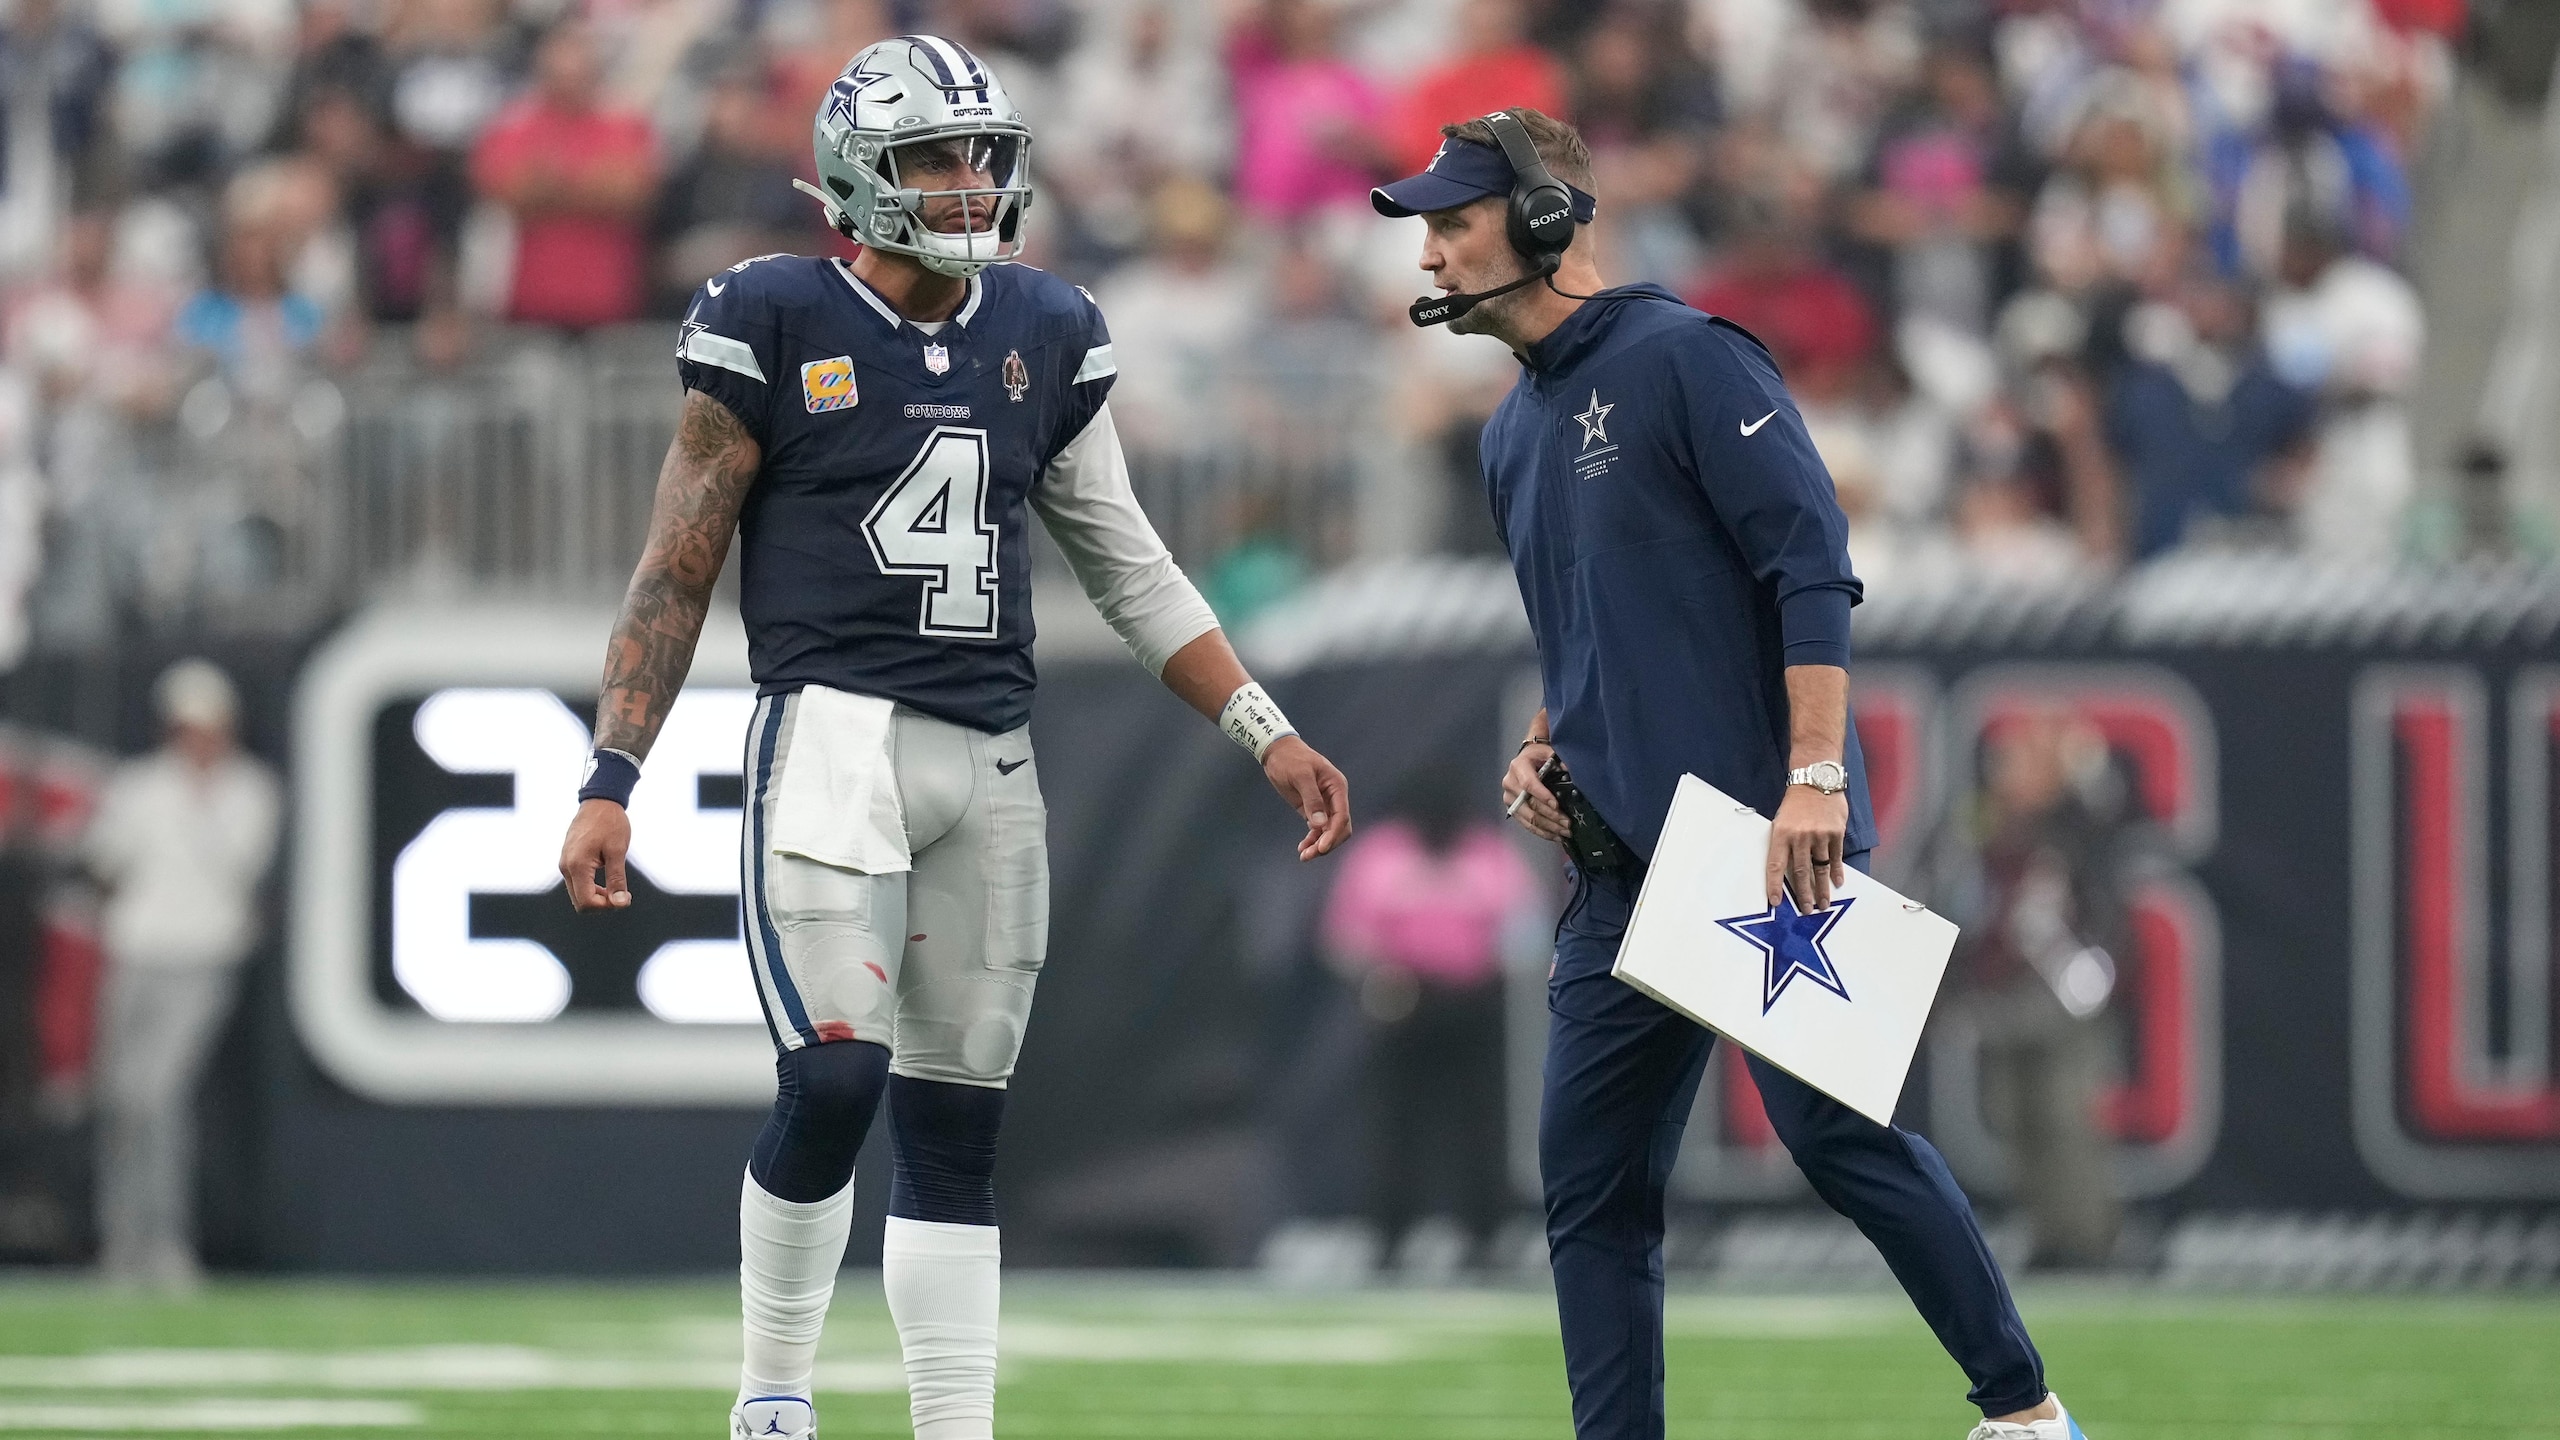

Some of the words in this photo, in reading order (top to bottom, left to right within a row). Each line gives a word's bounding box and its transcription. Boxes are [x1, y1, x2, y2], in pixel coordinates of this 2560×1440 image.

[1529, 206, 1571, 229] SONY
[1418, 304, 1450, 321] SONY
[903, 404, 971, 419] COWBOYS
[859, 424, 1000, 640] 4
[1230, 718, 1259, 749] FAITH
